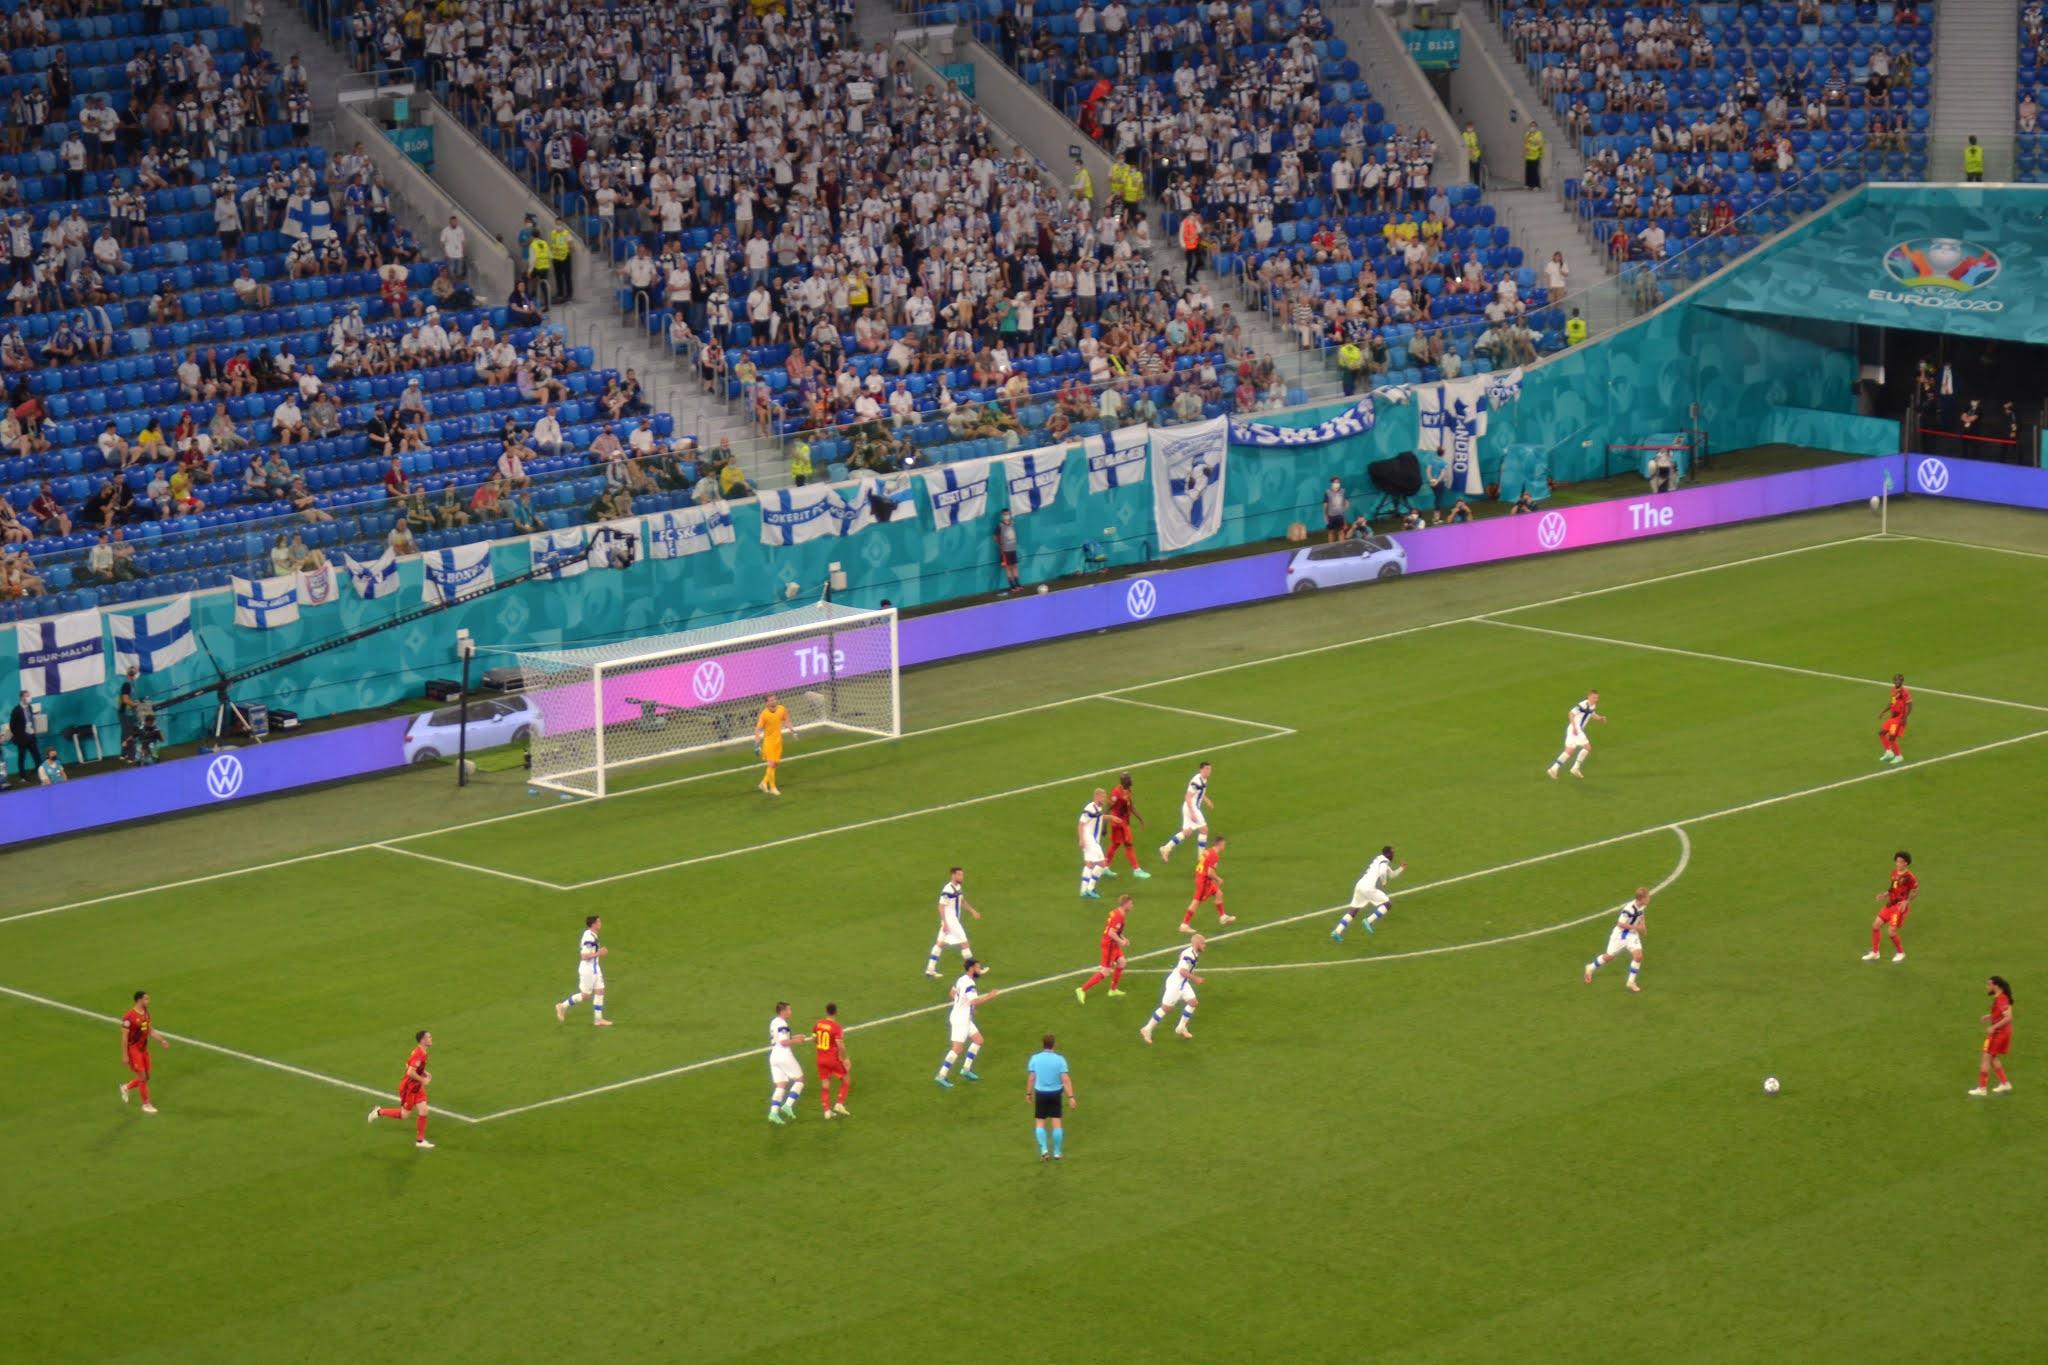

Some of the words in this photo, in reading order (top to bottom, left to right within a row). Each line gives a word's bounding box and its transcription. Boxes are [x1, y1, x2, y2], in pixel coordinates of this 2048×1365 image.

[1917, 457, 1949, 494] VW
[1538, 511, 1567, 548] VW
[1628, 502, 1674, 530] The
[1127, 579, 1157, 618] VW
[795, 646, 845, 678] The
[693, 661, 725, 701] VW
[207, 755, 243, 798] VW
[816, 1030, 830, 1050] 10
